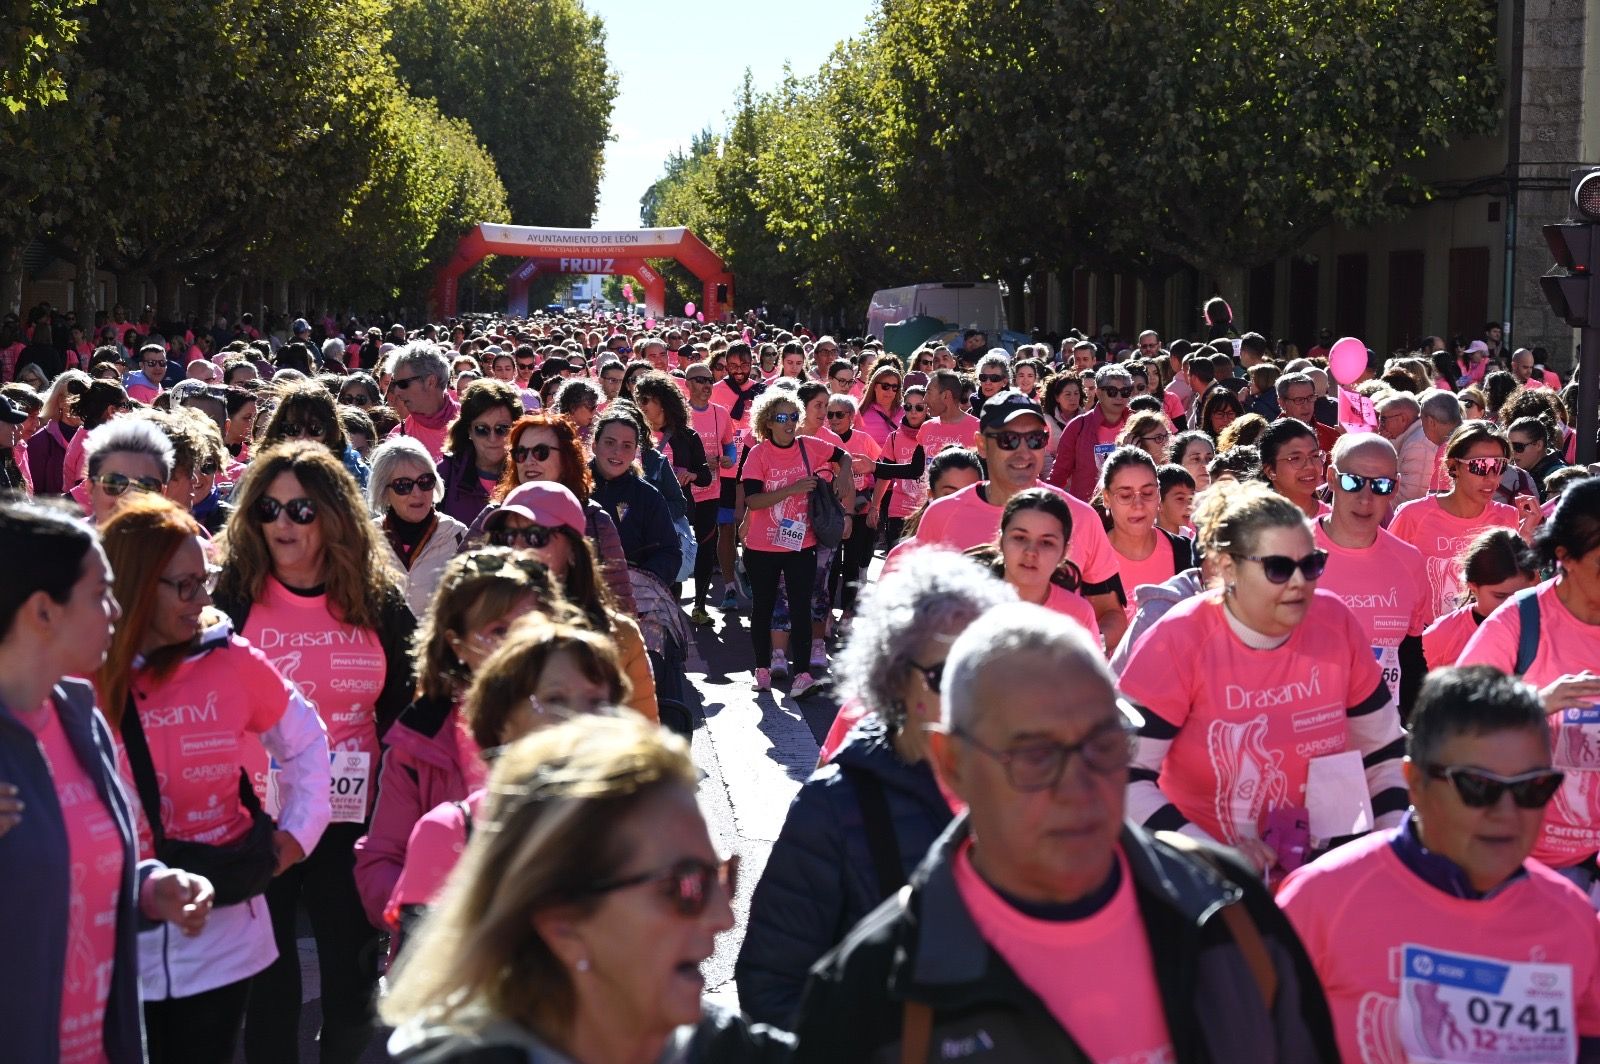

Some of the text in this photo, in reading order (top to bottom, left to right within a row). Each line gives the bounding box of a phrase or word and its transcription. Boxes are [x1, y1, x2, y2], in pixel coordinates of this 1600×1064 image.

[527, 234, 638, 244] AYUNTAMIENTO DE LEÓN
[560, 258, 614, 272] FROIZ
[782, 528, 802, 540] 5466
[1383, 668, 1398, 682] 56
[330, 777, 364, 794] 207
[1545, 824, 1593, 838] Carrera
[1468, 998, 1566, 1034] 0741
[1472, 1029, 1498, 1050] 12
